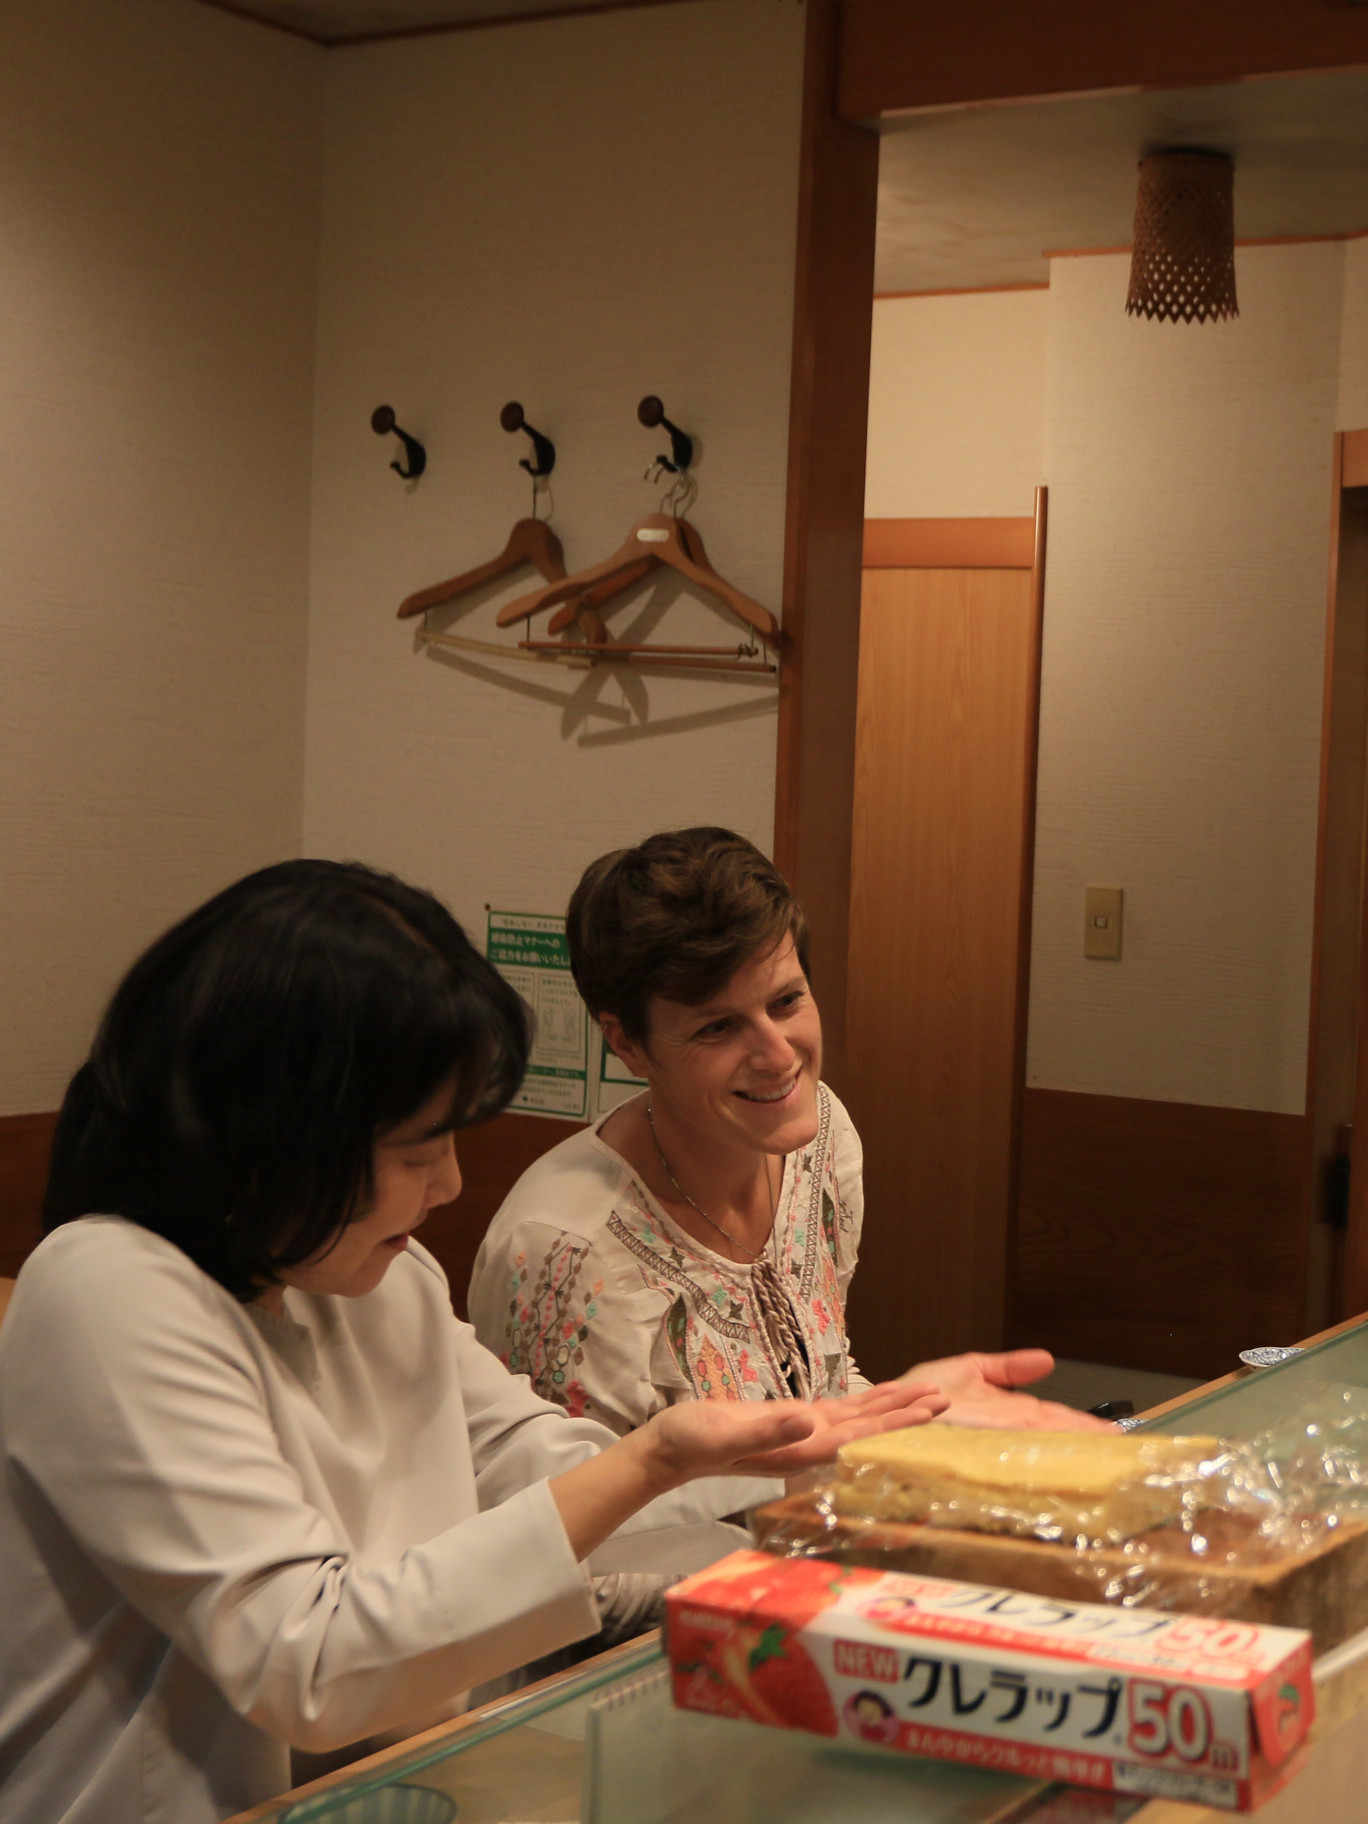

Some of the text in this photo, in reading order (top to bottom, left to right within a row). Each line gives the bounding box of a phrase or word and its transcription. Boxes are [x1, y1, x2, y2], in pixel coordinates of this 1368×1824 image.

[837, 1644, 894, 1680] NEW
[903, 1656, 1122, 1739] クレラップ
